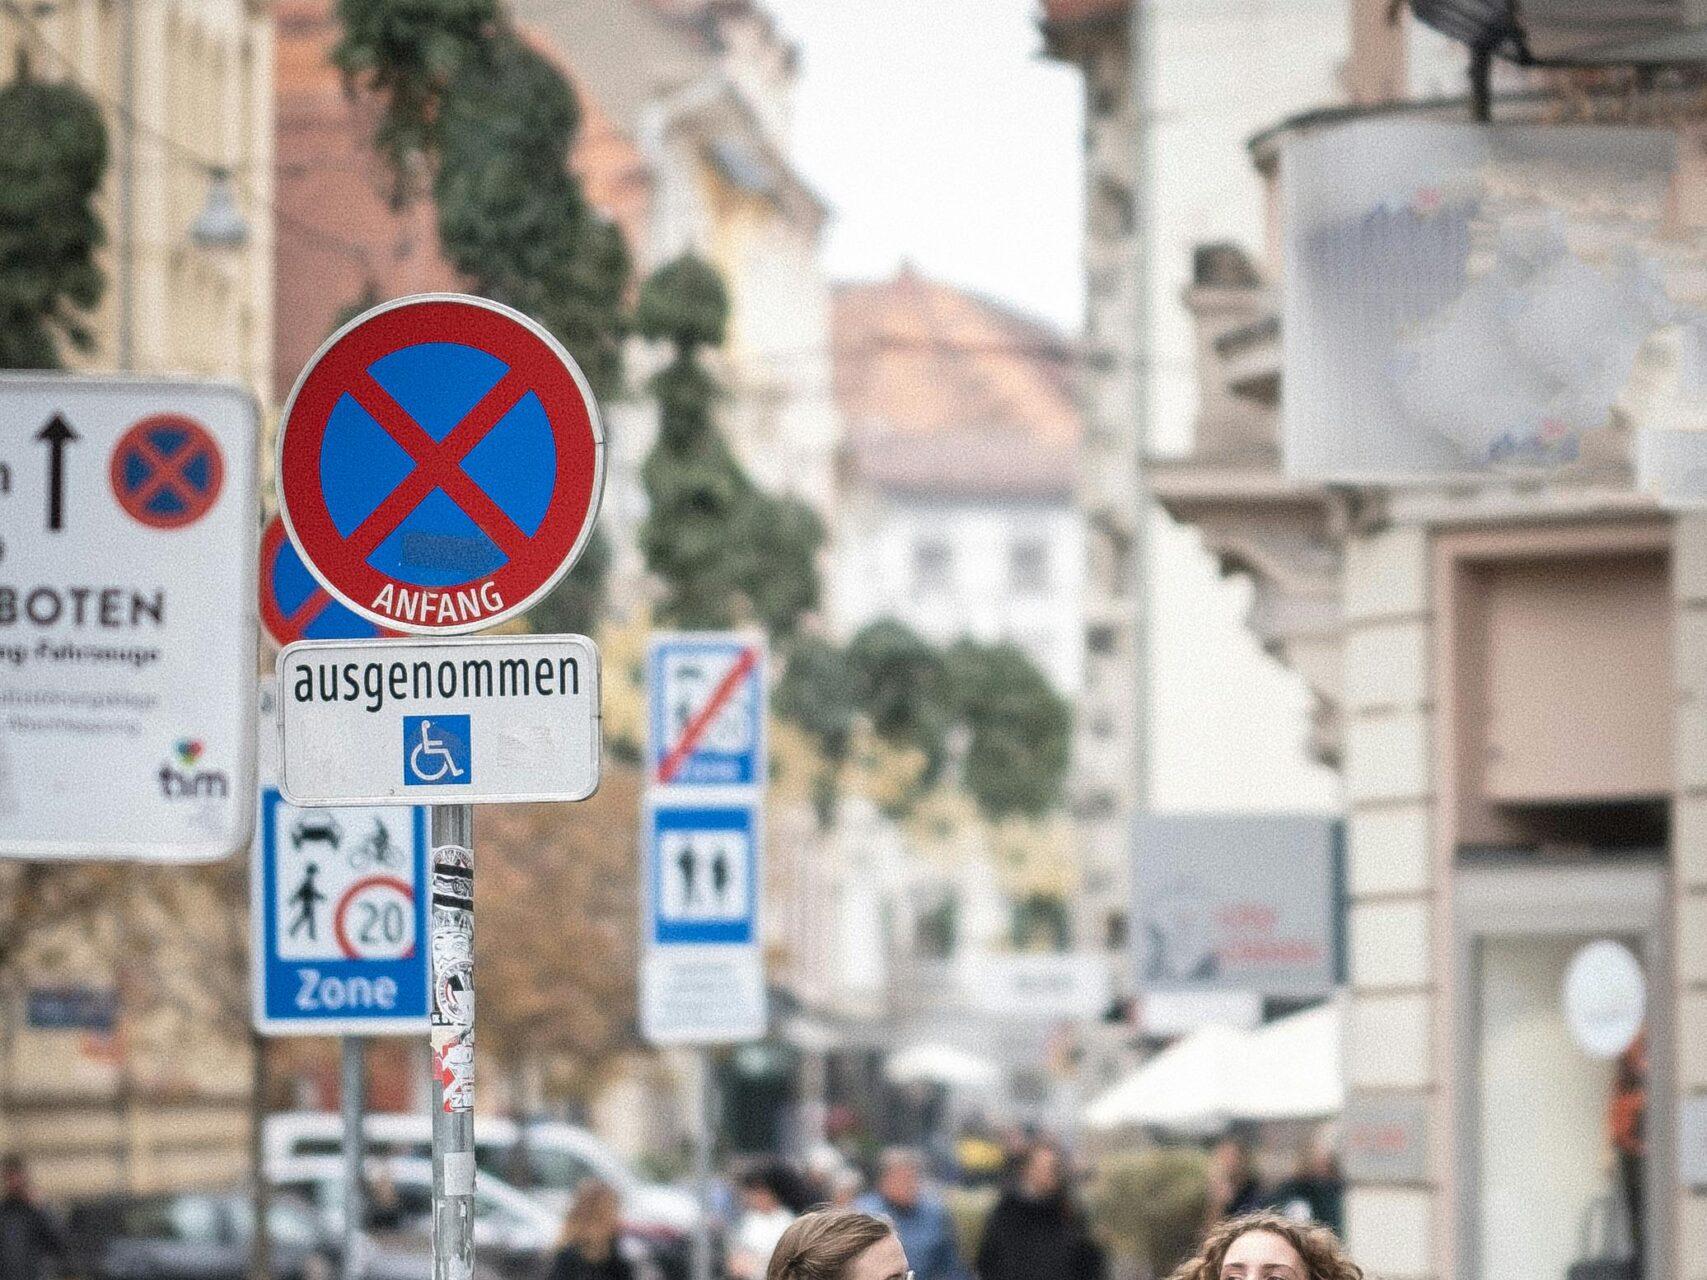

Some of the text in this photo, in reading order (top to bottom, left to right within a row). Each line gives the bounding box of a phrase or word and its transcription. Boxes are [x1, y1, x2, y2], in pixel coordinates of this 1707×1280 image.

[371, 581, 504, 624] ANFANG
[294, 656, 580, 713] ausgenommen
[358, 901, 404, 944] 20
[295, 969, 399, 1010] Zone
